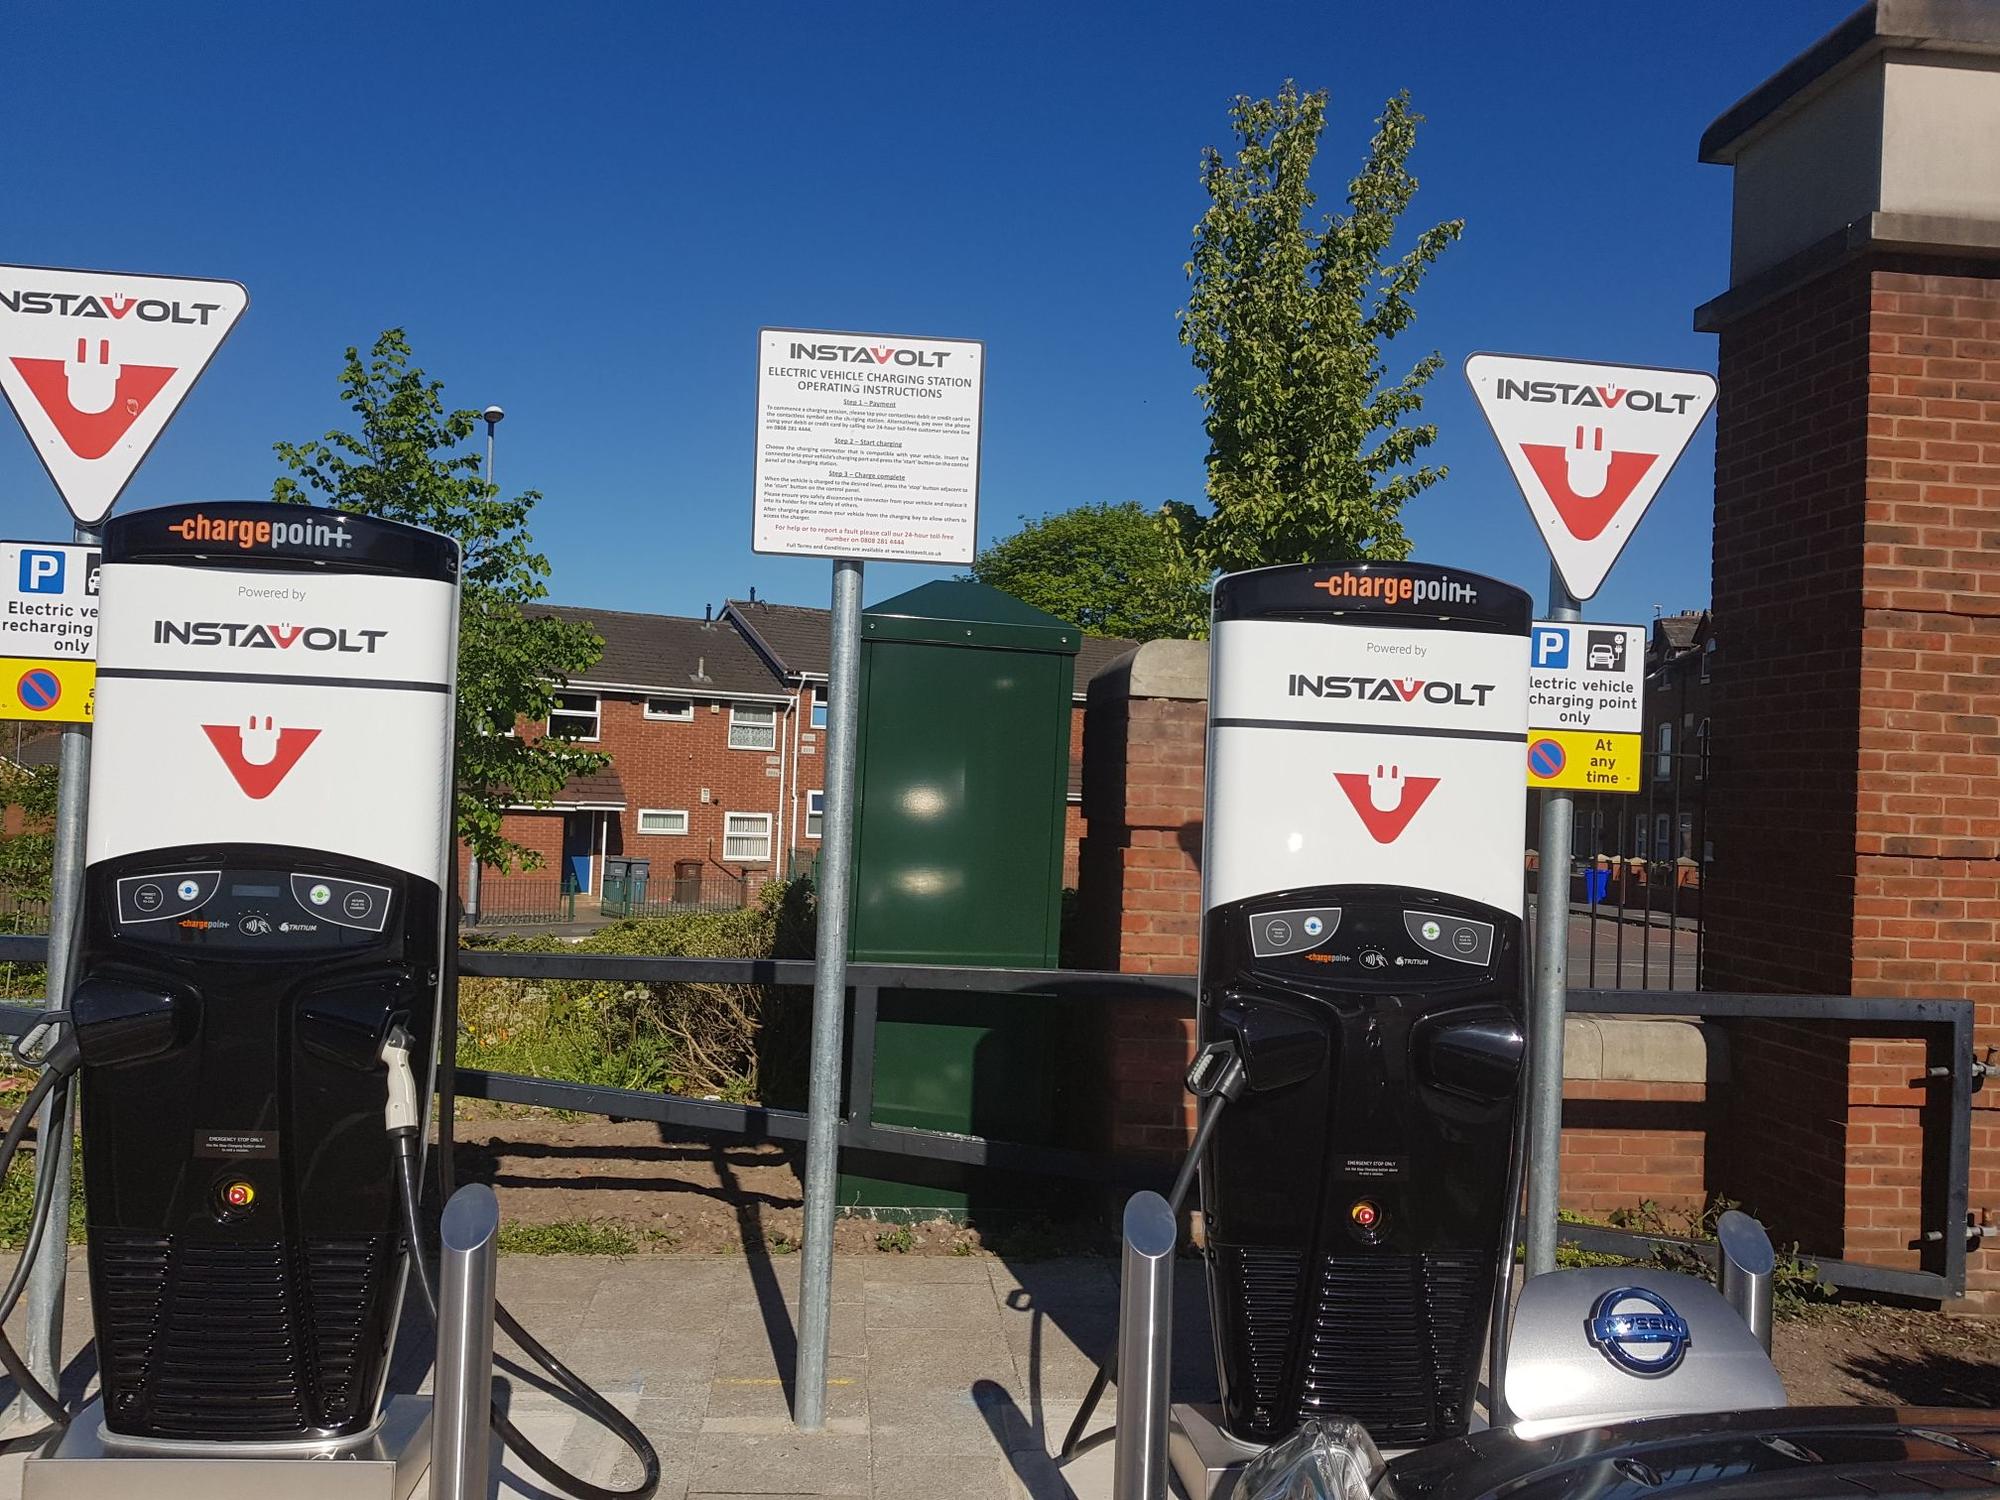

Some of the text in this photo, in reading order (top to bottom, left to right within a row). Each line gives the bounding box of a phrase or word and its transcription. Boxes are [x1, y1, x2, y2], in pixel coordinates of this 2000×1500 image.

[0, 290, 221, 325] NSTAVOLT
[790, 343, 951, 368] INSTAVOLT
[768, 366, 972, 387] ELECTRIC VEHICLE CHARGING STATION
[798, 381, 942, 398] OPERATING INSTRUCTIONS
[1496, 378, 1695, 414] INSTAVOLT
[170, 514, 352, 548] chargepoint
[30, 554, 58, 590] P
[238, 586, 306, 602] Powered by
[1314, 572, 1477, 604] chargepoint
[8, 601, 74, 617] Electric
[2, 620, 93, 637] recharging
[154, 620, 388, 653] INSTAVOLT
[54, 638, 90, 654] only
[1366, 642, 1427, 658] Powered by
[1538, 632, 1564, 664] P
[1288, 674, 1496, 706] INSTAVOLT
[1530, 676, 1634, 693] lectric vehicle
[1529, 694, 1638, 710] charging point
[1560, 711, 1591, 725] only
[1595, 739, 1612, 752] At
[1590, 756, 1616, 770] any
[1586, 771, 1619, 784] time
[179, 920, 230, 930] chargepoint
[1305, 953, 1351, 963] chargepoint
